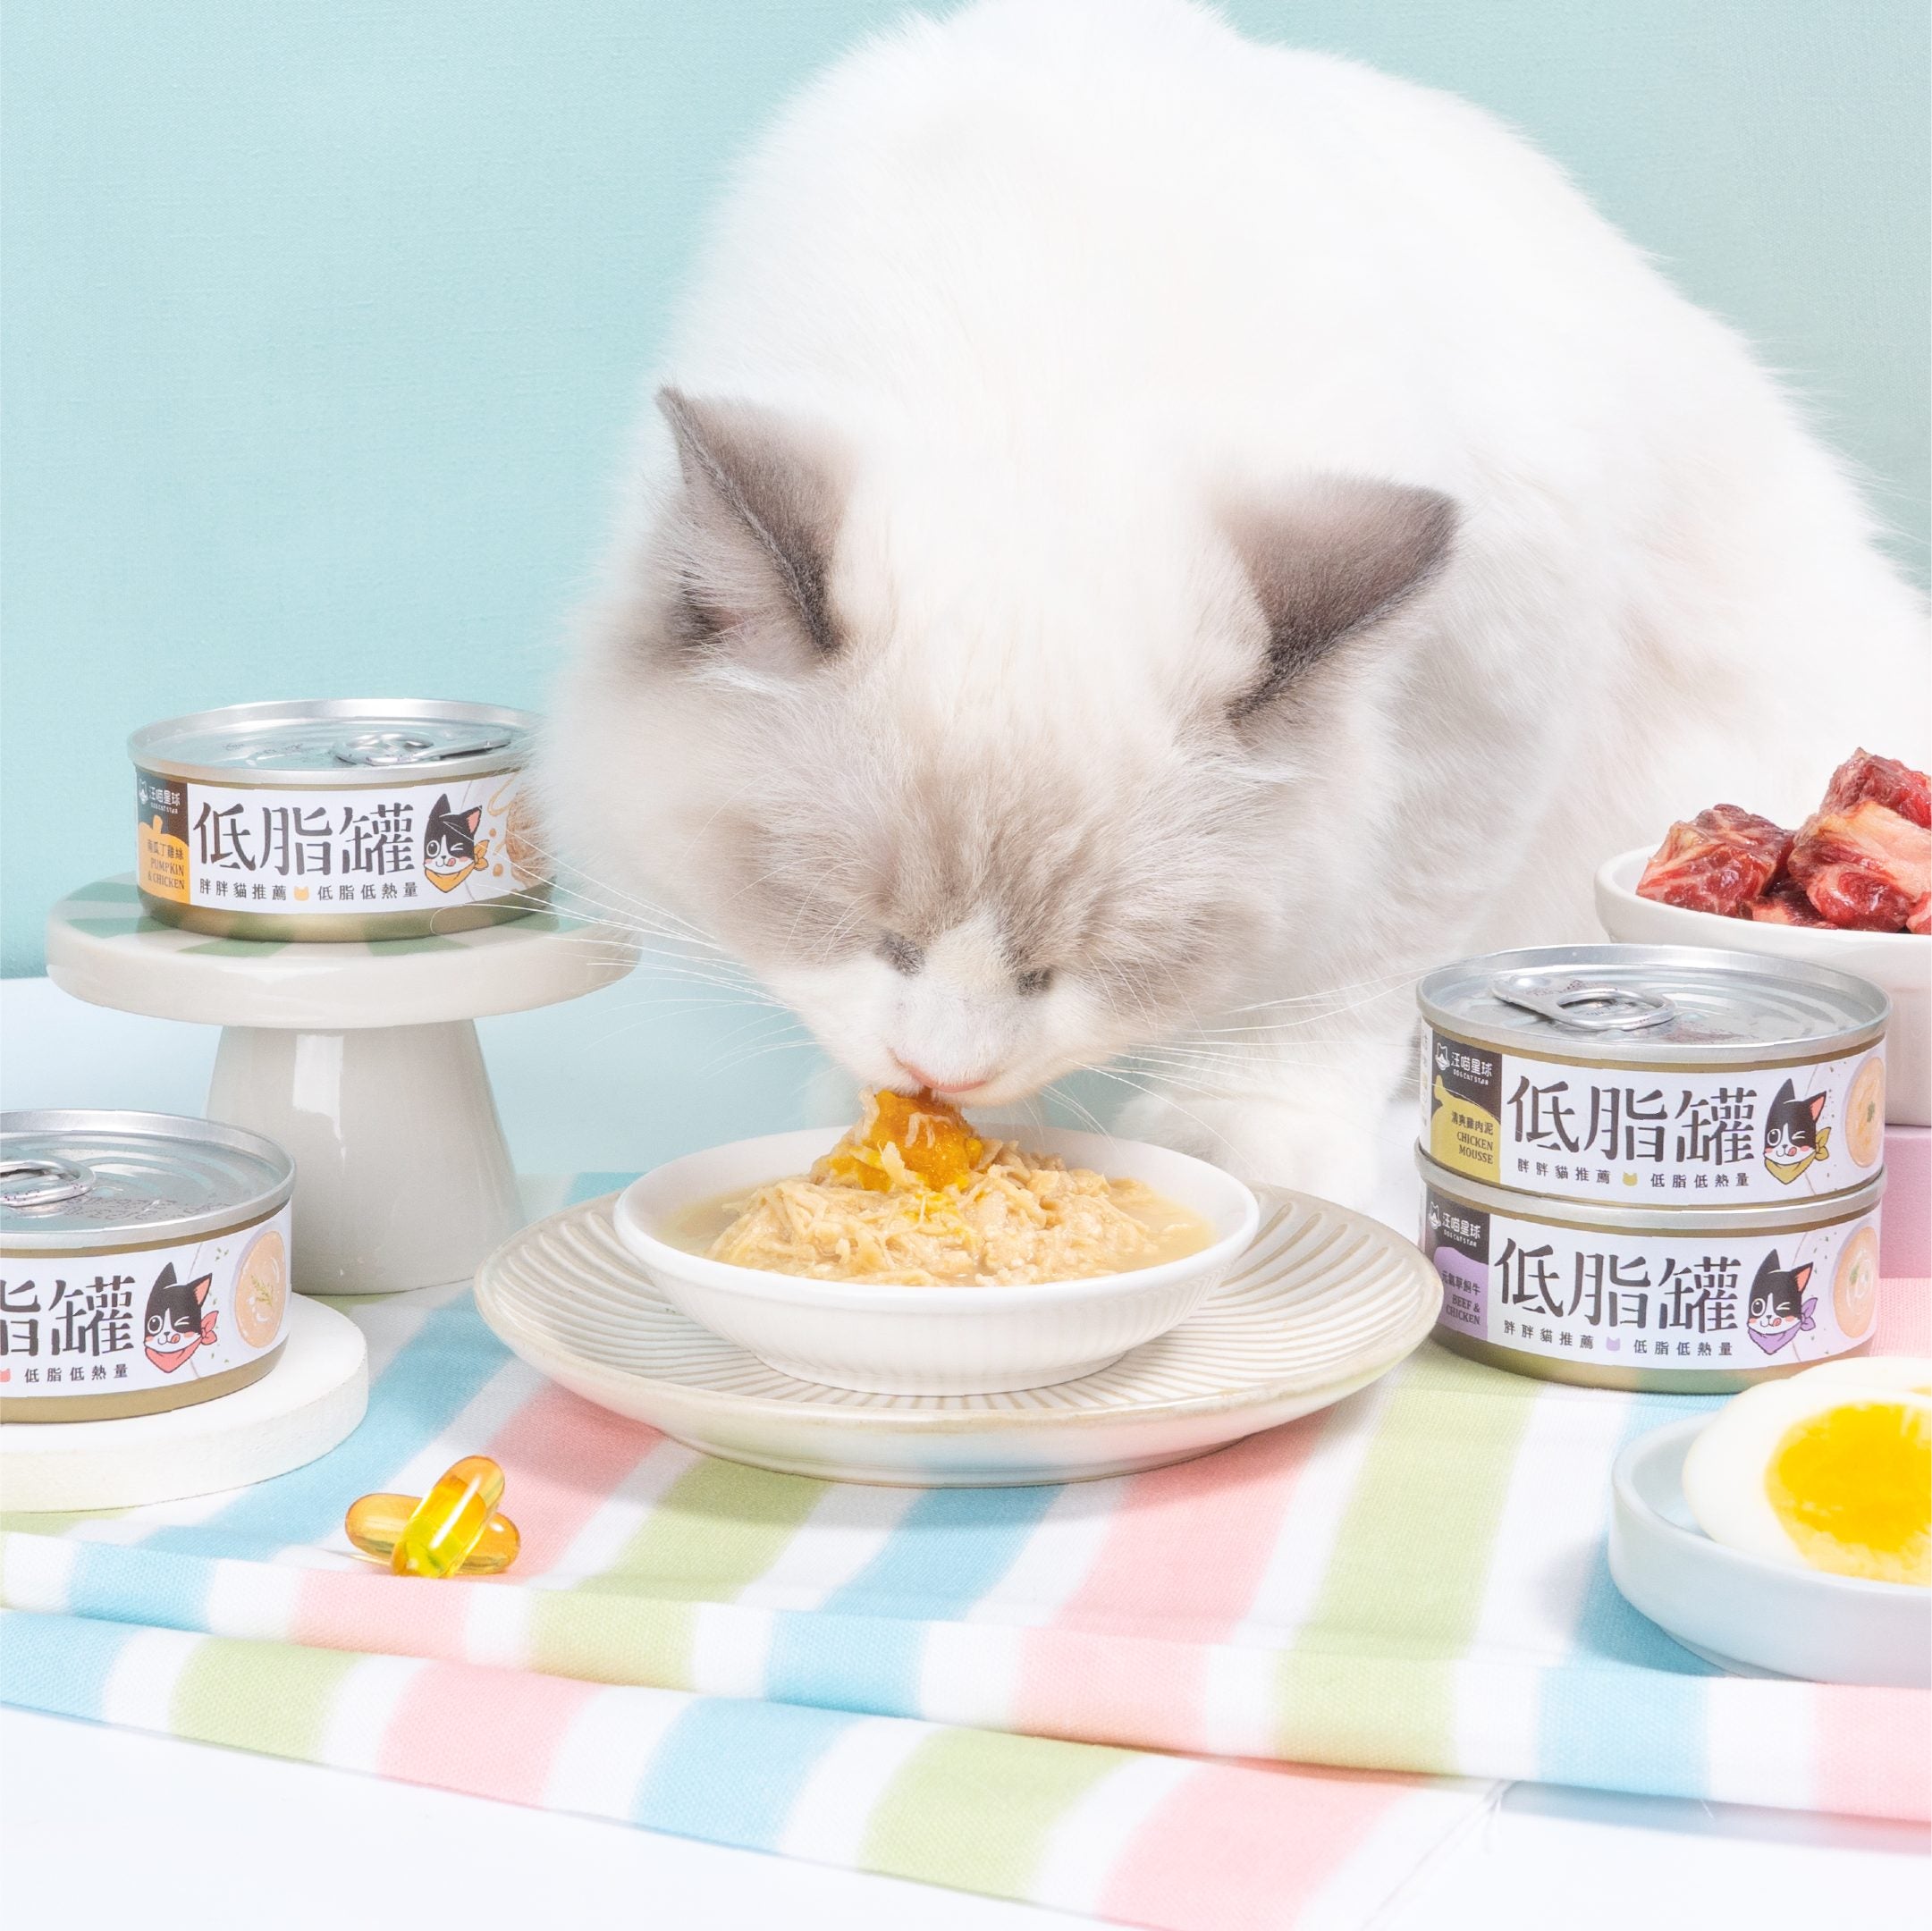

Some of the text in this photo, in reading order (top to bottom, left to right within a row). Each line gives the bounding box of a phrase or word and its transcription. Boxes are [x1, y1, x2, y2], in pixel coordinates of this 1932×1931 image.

[192, 801, 415, 877] 低脂罐
[150, 857, 184, 876] PUMPKIN
[153, 874, 185, 890] CHICKEN
[199, 878, 418, 901] 胖胖貓推薦 低脂低熱量
[1450, 1051, 1493, 1077] 汪喵星球
[1451, 1110, 1494, 1136] 清爽雞肉泥
[1506, 1075, 1758, 1166] 低脂罐
[1456, 1131, 1494, 1151] CHICKEN
[1458, 1144, 1494, 1165] MOUSSE
[1517, 1158, 1750, 1190] 胖胖貓推薦 低脂低熱量
[1442, 1211, 1481, 1240] 汪喵星球
[1494, 1237, 1742, 1334] 低脂罐
[1446, 1304, 1481, 1325] CHICKEN
[1452, 1294, 1481, 1313] BEEF &
[1504, 1320, 1733, 1356] 胖胖貓推薦 低脂低熱量
[24, 1363, 128, 1384] 低脂低熱量
